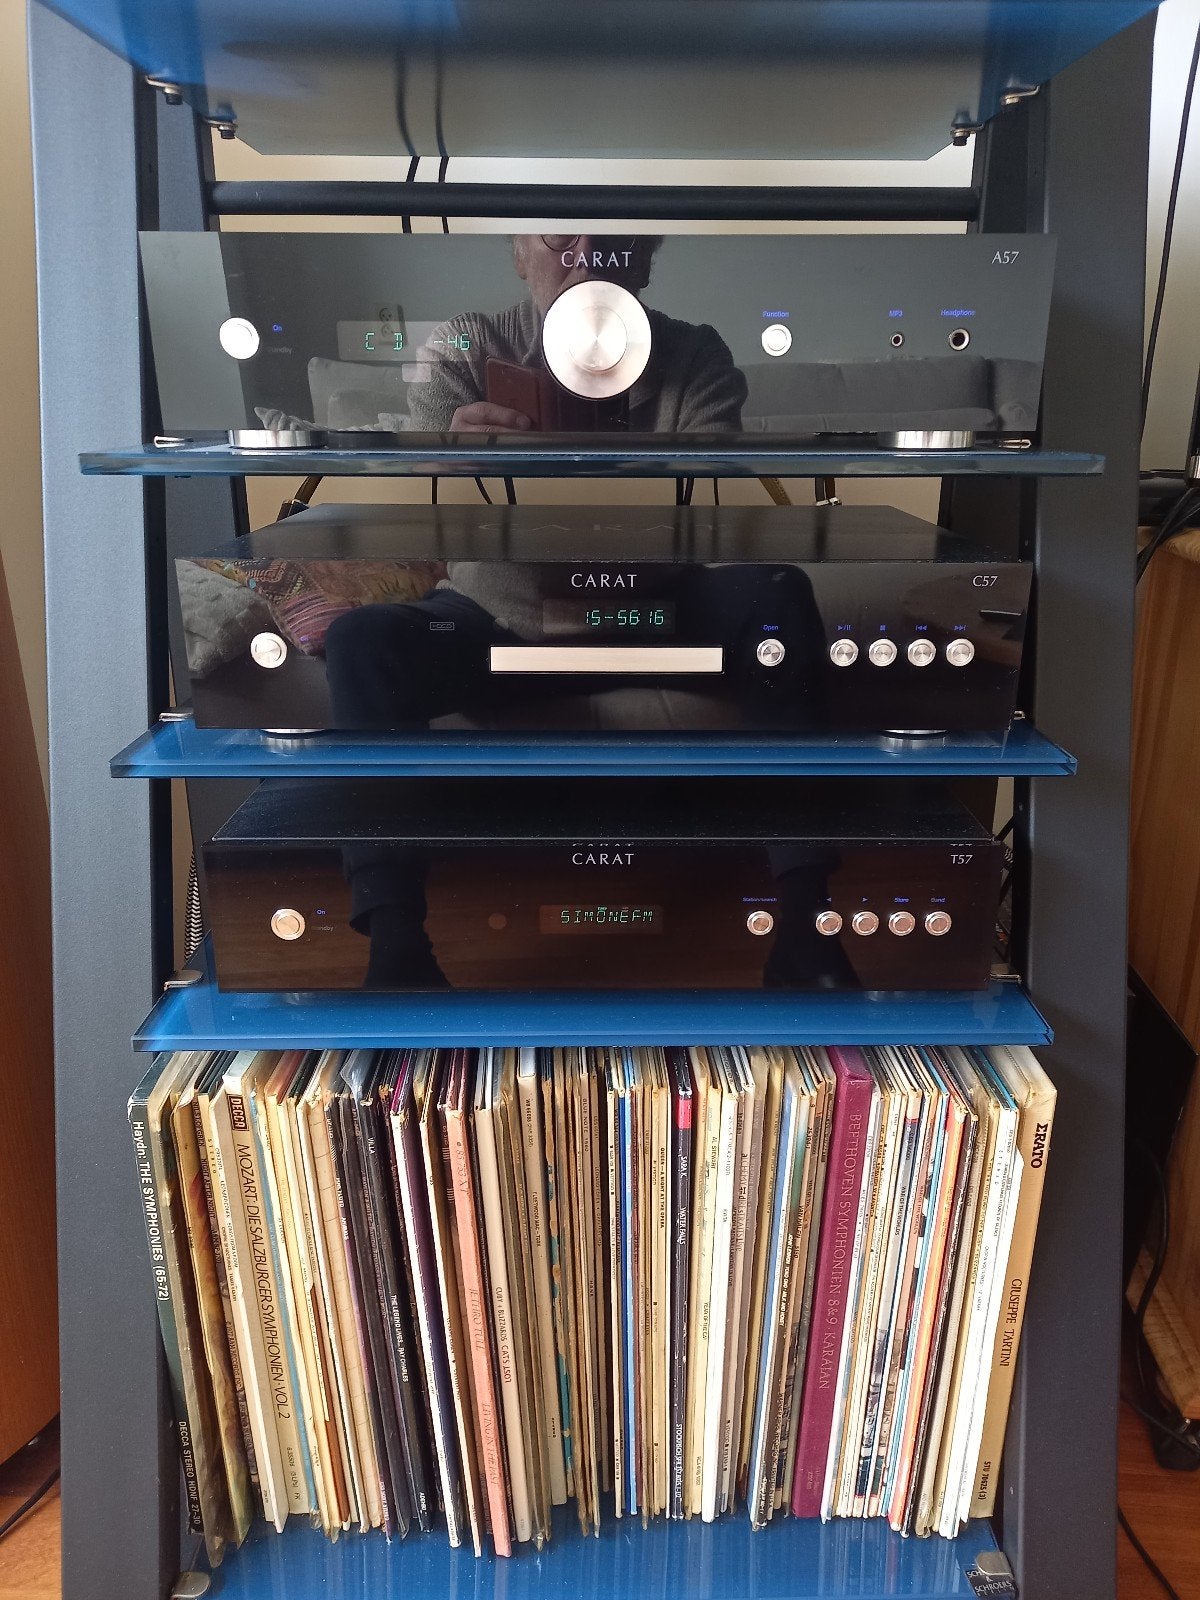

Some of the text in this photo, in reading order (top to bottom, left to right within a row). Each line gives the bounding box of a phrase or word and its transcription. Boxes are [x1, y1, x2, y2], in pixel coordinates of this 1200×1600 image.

[560, 250, 633, 268] CARAT
[991, 250, 1020, 265] A57
[762, 310, 790, 318] Function
[272, 324, 283, 332] On
[571, 573, 637, 589] CARAT
[972, 574, 998, 588] C57
[763, 623, 779, 632] Open
[571, 852, 635, 865] CARAT
[950, 853, 973, 865] T57
[231, 1096, 247, 1129] DECCA
[711, 1135, 717, 1144] AL
[840, 1112, 861, 1197] BEETHOVEN
[236, 1141, 258, 1204] MOZART:
[336, 1188, 344, 1208] FLOYD
[131, 1120, 169, 1302] Haydn: THE SYMPHONIES (65-72)
[245, 1203, 262, 1227] DIE
[894, 1213, 902, 1236] WORLDS
[834, 1200, 851, 1294] SYMPHONIEN
[249, 1224, 273, 1303] SALZBURGER
[494, 1286, 503, 1303] CUBY
[468, 1286, 485, 1351] JETHRO TULL
[497, 1308, 507, 1342] BLIZZARDS
[998, 1277, 1023, 1367] GIUSEPPE TARTINI
[260, 1301, 285, 1383] SYMPHONIEN
[390, 1294, 408, 1382] THE LEGEND RAY CHARLES
[500, 1344, 510, 1364] CATS
[817, 1330, 836, 1390] KARAJAN
[178, 1420, 190, 1447] DECCA
[182, 1448, 194, 1478] STEREO
[187, 1479, 197, 1502] HDNF
